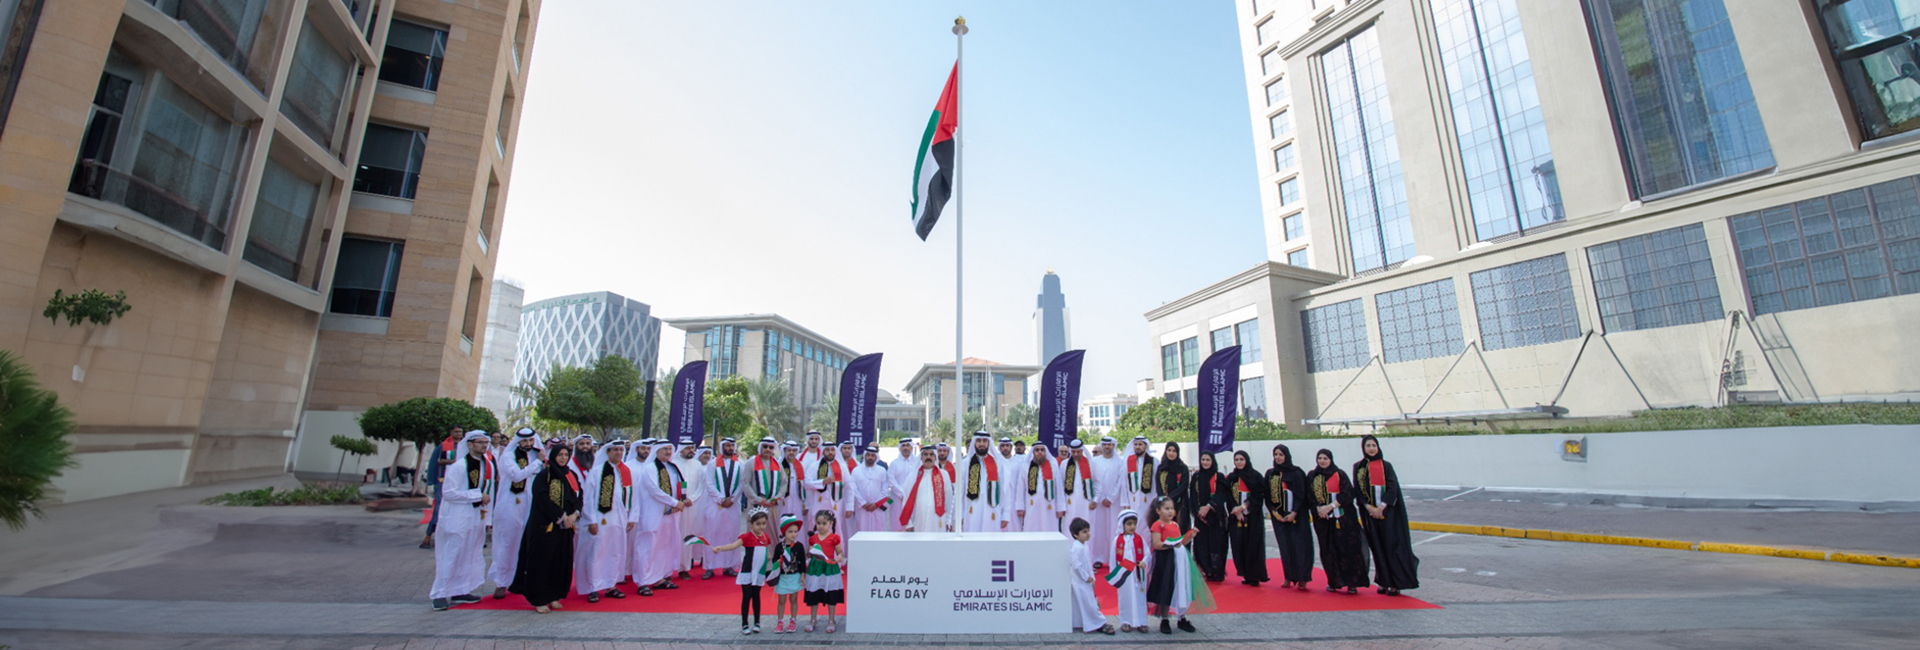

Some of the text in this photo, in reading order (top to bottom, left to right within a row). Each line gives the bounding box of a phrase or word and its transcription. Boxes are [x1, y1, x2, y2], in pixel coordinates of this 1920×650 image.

[686, 380, 696, 433] EMIRATES ISLAMIC
[857, 373, 867, 429] EMIRATES ISLAMIC
[1217, 396, 1225, 427] EMIRATES
[871, 575, 929, 585] يوم العلم
[870, 588, 929, 599] FLAG DAY
[953, 588, 1053, 600] الإمارات الإسلامي
[953, 602, 1053, 612] EMIRATES ISLAMIC
